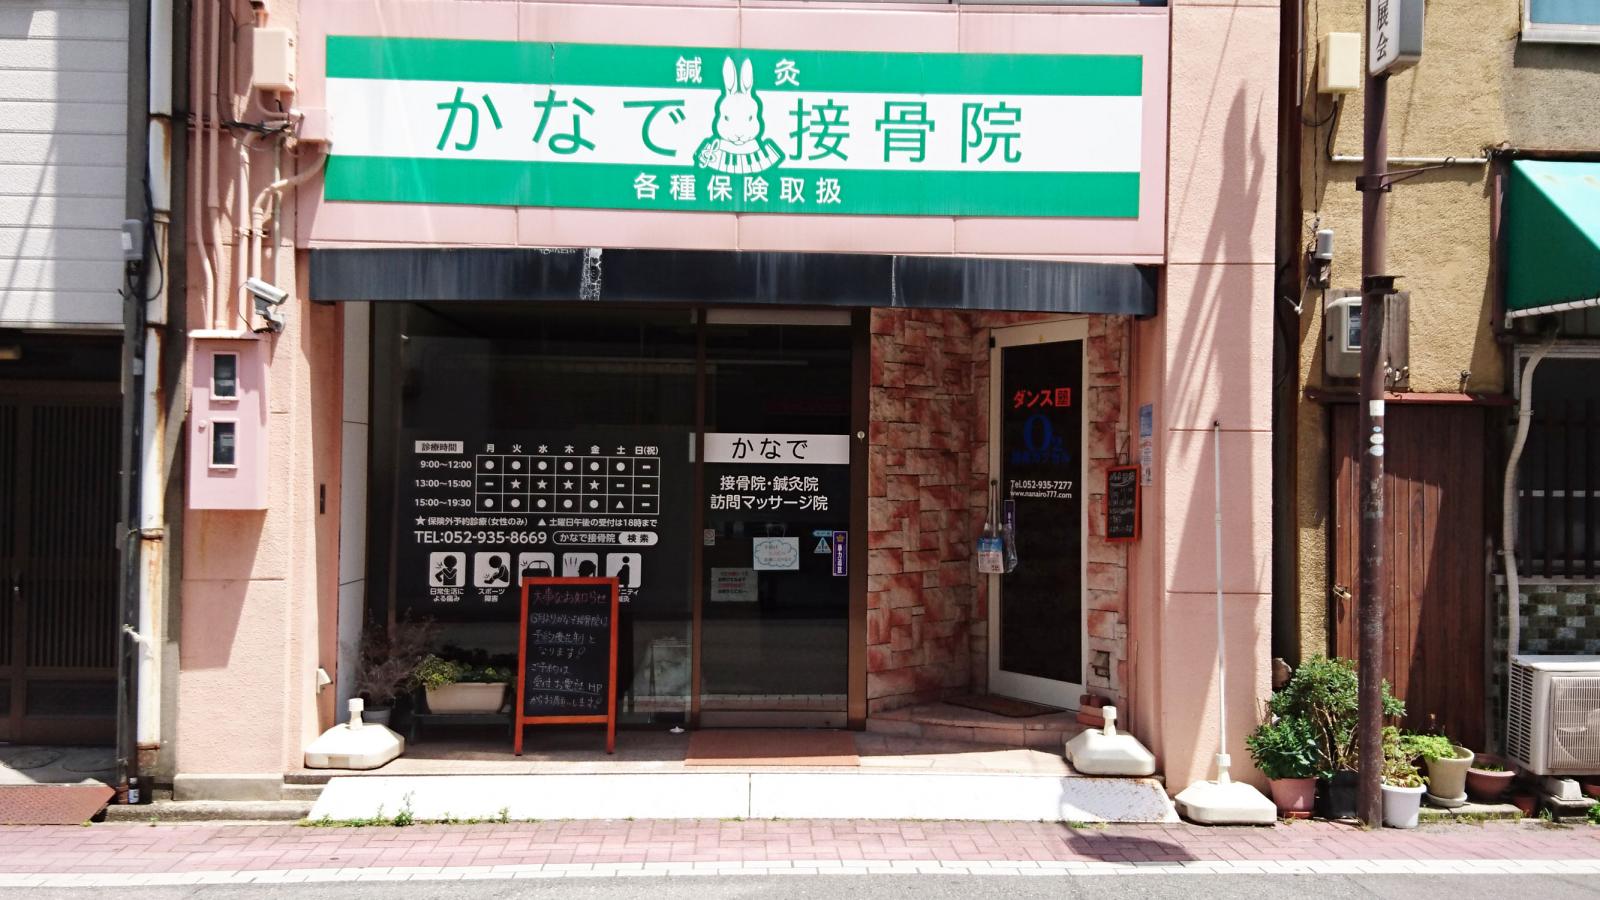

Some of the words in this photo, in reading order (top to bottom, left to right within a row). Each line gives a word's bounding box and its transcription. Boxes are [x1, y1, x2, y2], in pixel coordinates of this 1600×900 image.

[676, 56, 702, 83] 鍼
[774, 58, 801, 85] 灸
[436, 86, 686, 158] かなで
[788, 99, 1023, 163] 接骨院
[633, 172, 842, 205] 各種保険取扱
[421, 442, 458, 452] 診療時間
[486, 443, 495, 453] 月
[512, 444, 522, 453] 火
[538, 444, 548, 453] 水
[564, 445, 574, 454] 木
[590, 445, 600, 454] 金
[616, 446, 626, 454] 土
[635, 446, 659, 456] 日(祝)
[731, 437, 808, 460] かなで
[720, 475, 819, 491] 接骨院・鍼灸院
[710, 494, 829, 511] 訪問マッサージ院
[414, 530, 547, 544] TEL:052-935-8669
[560, 533, 616, 543] かなで接骨院
[430, 587, 465, 595] 日常生活に
